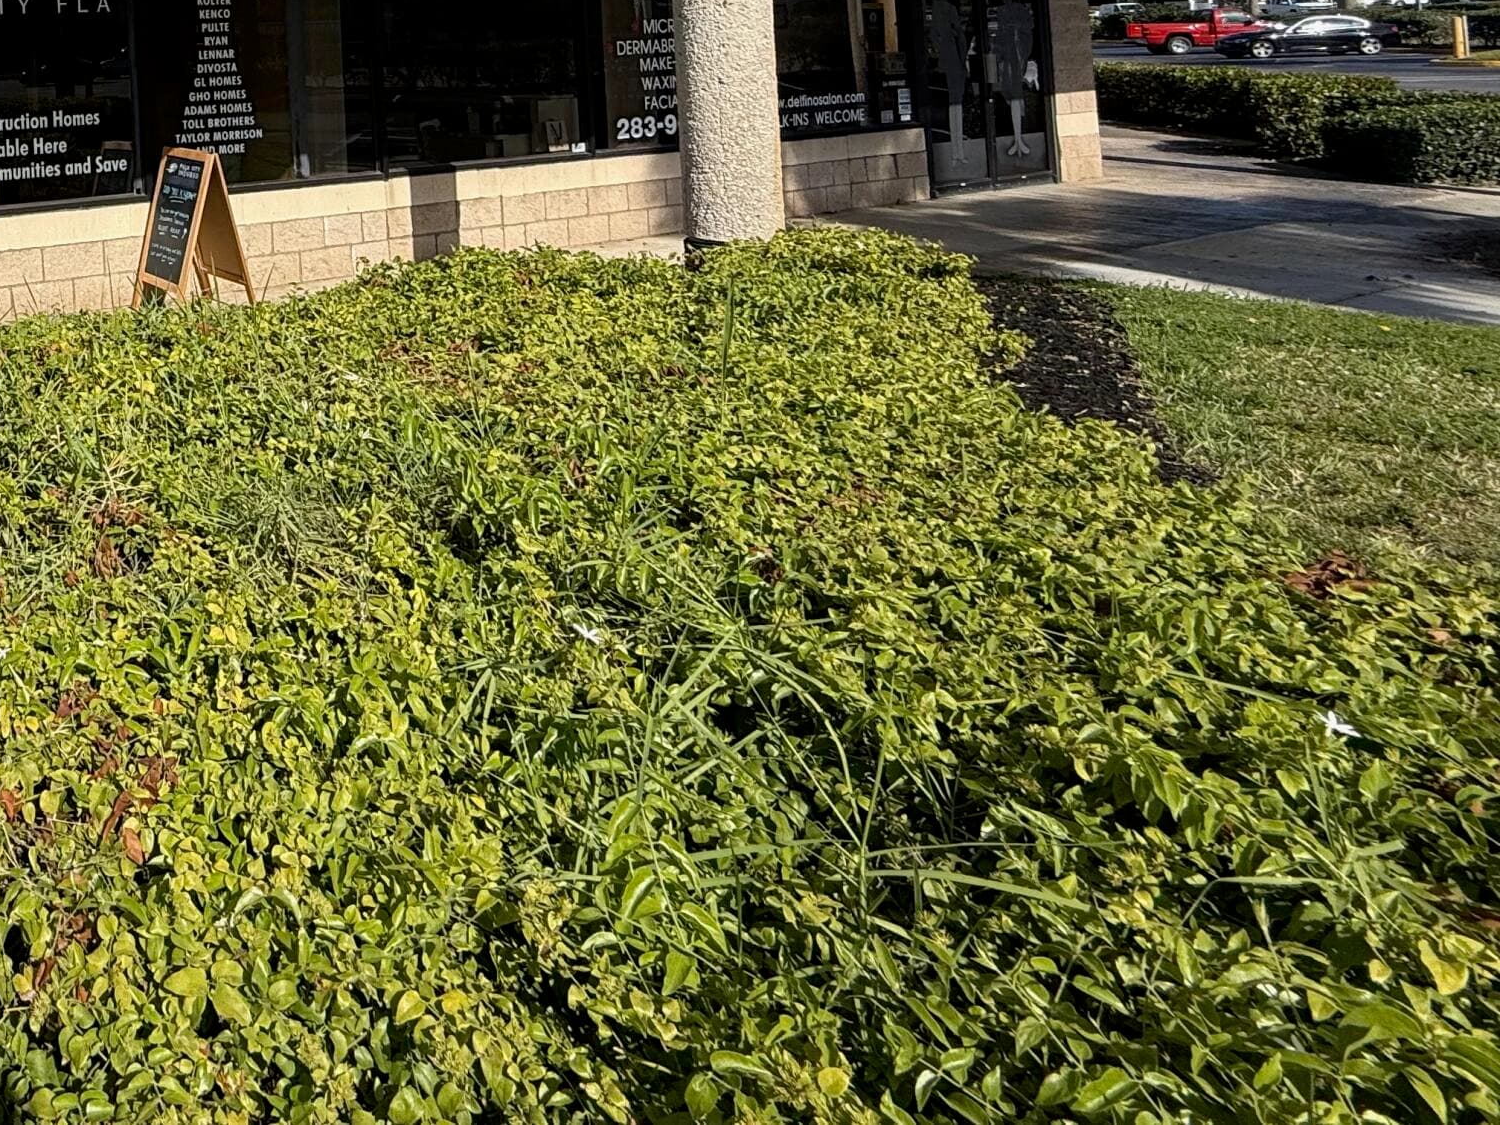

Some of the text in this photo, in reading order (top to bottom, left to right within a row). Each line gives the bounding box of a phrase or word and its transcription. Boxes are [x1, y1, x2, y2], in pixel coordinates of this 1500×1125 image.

[199, 9, 231, 19] KENCO
[201, 22, 230, 33] PULTE
[204, 36, 228, 46] RYAN
[616, 38, 675, 56] DERMABR
[198, 49, 235, 60] LENNAR
[197, 62, 237, 74] DIVOSTA
[194, 76, 242, 87] GL HOMES
[189, 89, 246, 102] GHO HOMES
[184, 103, 253, 116] ADAMS HOMES
[52, 110, 101, 127] Homes
[182, 116, 255, 130] TOLL BROTHERS
[815, 108, 866, 126] WELCOME
[616, 113, 677, 140] 283-9
[175, 129, 263, 144] TAYLOR MORRISON
[33, 137, 67, 155] Here
[219, 143, 245, 154] MORE
[65, 156, 91, 175] and
[95, 155, 128, 173] Save
